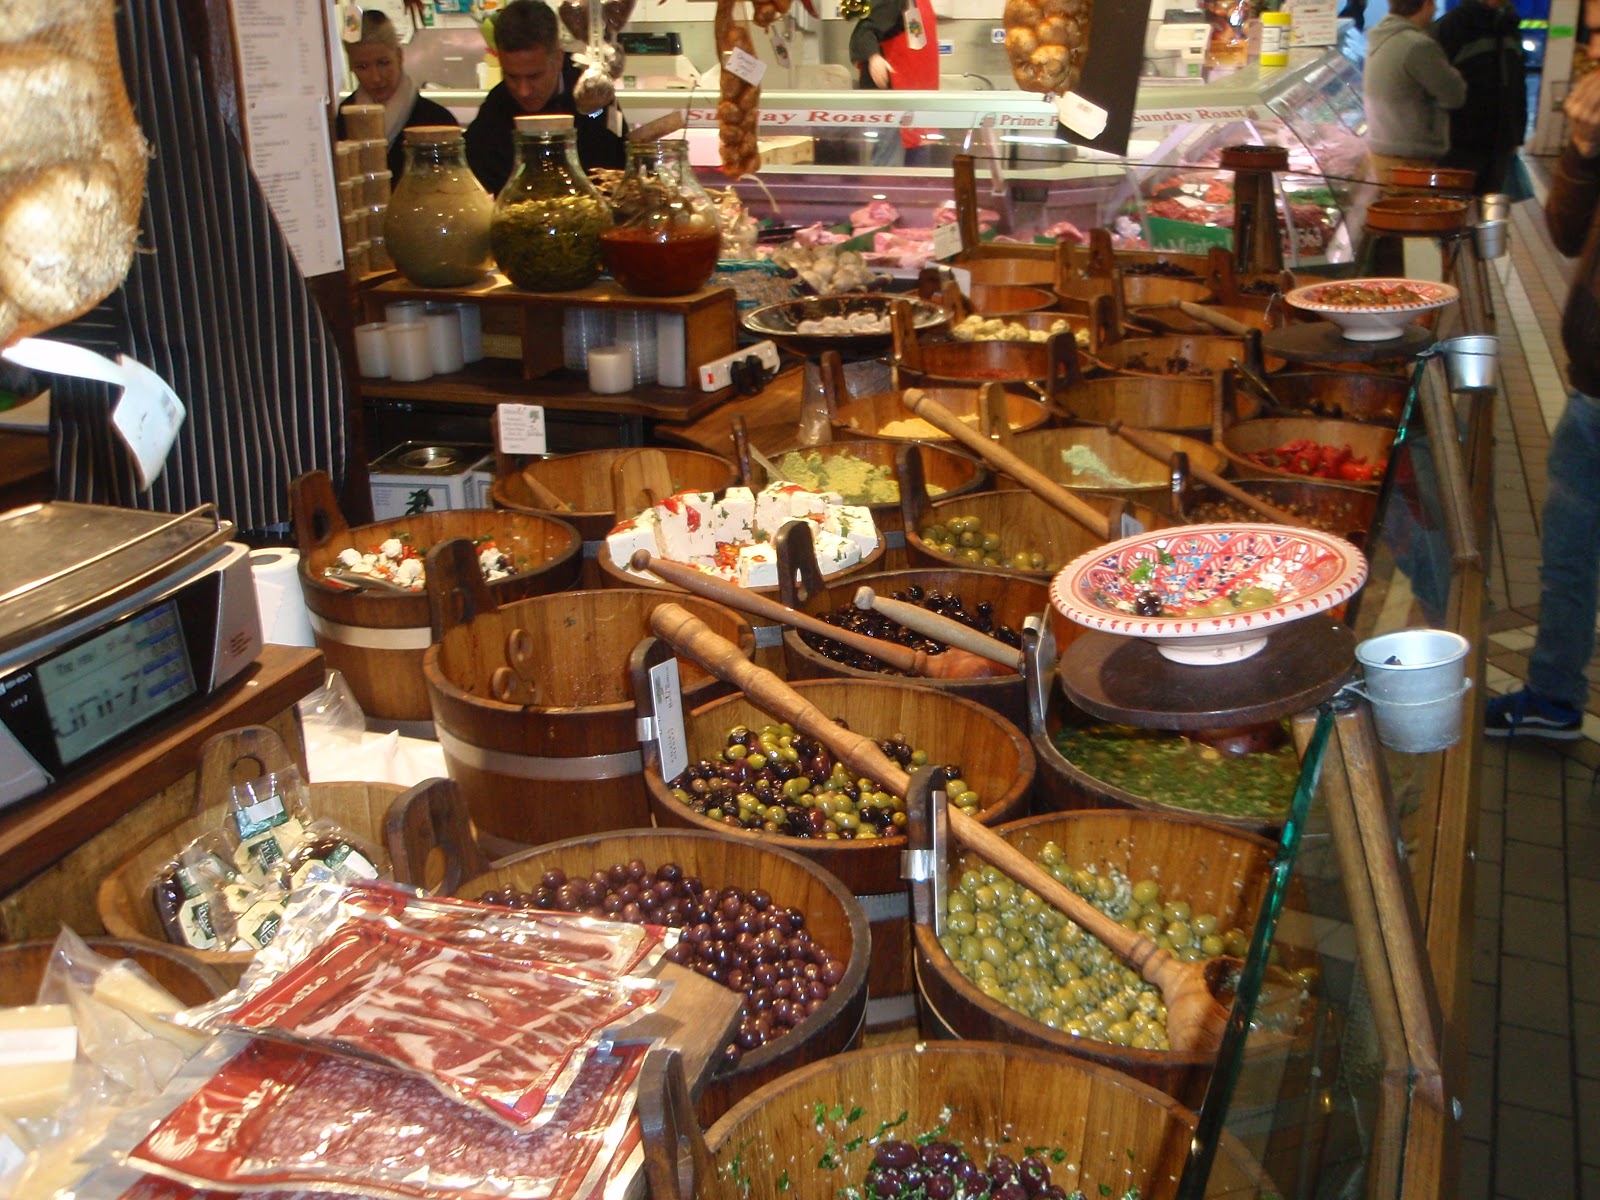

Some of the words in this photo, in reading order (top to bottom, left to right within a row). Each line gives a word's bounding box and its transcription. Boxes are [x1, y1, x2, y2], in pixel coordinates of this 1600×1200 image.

[687, 108, 797, 125] Suay
[806, 109, 896, 124] Roast
[1000, 114, 1044, 127] Prime
[1133, 110, 1193, 123] Sunday
[1199, 109, 1246, 121] Roast
